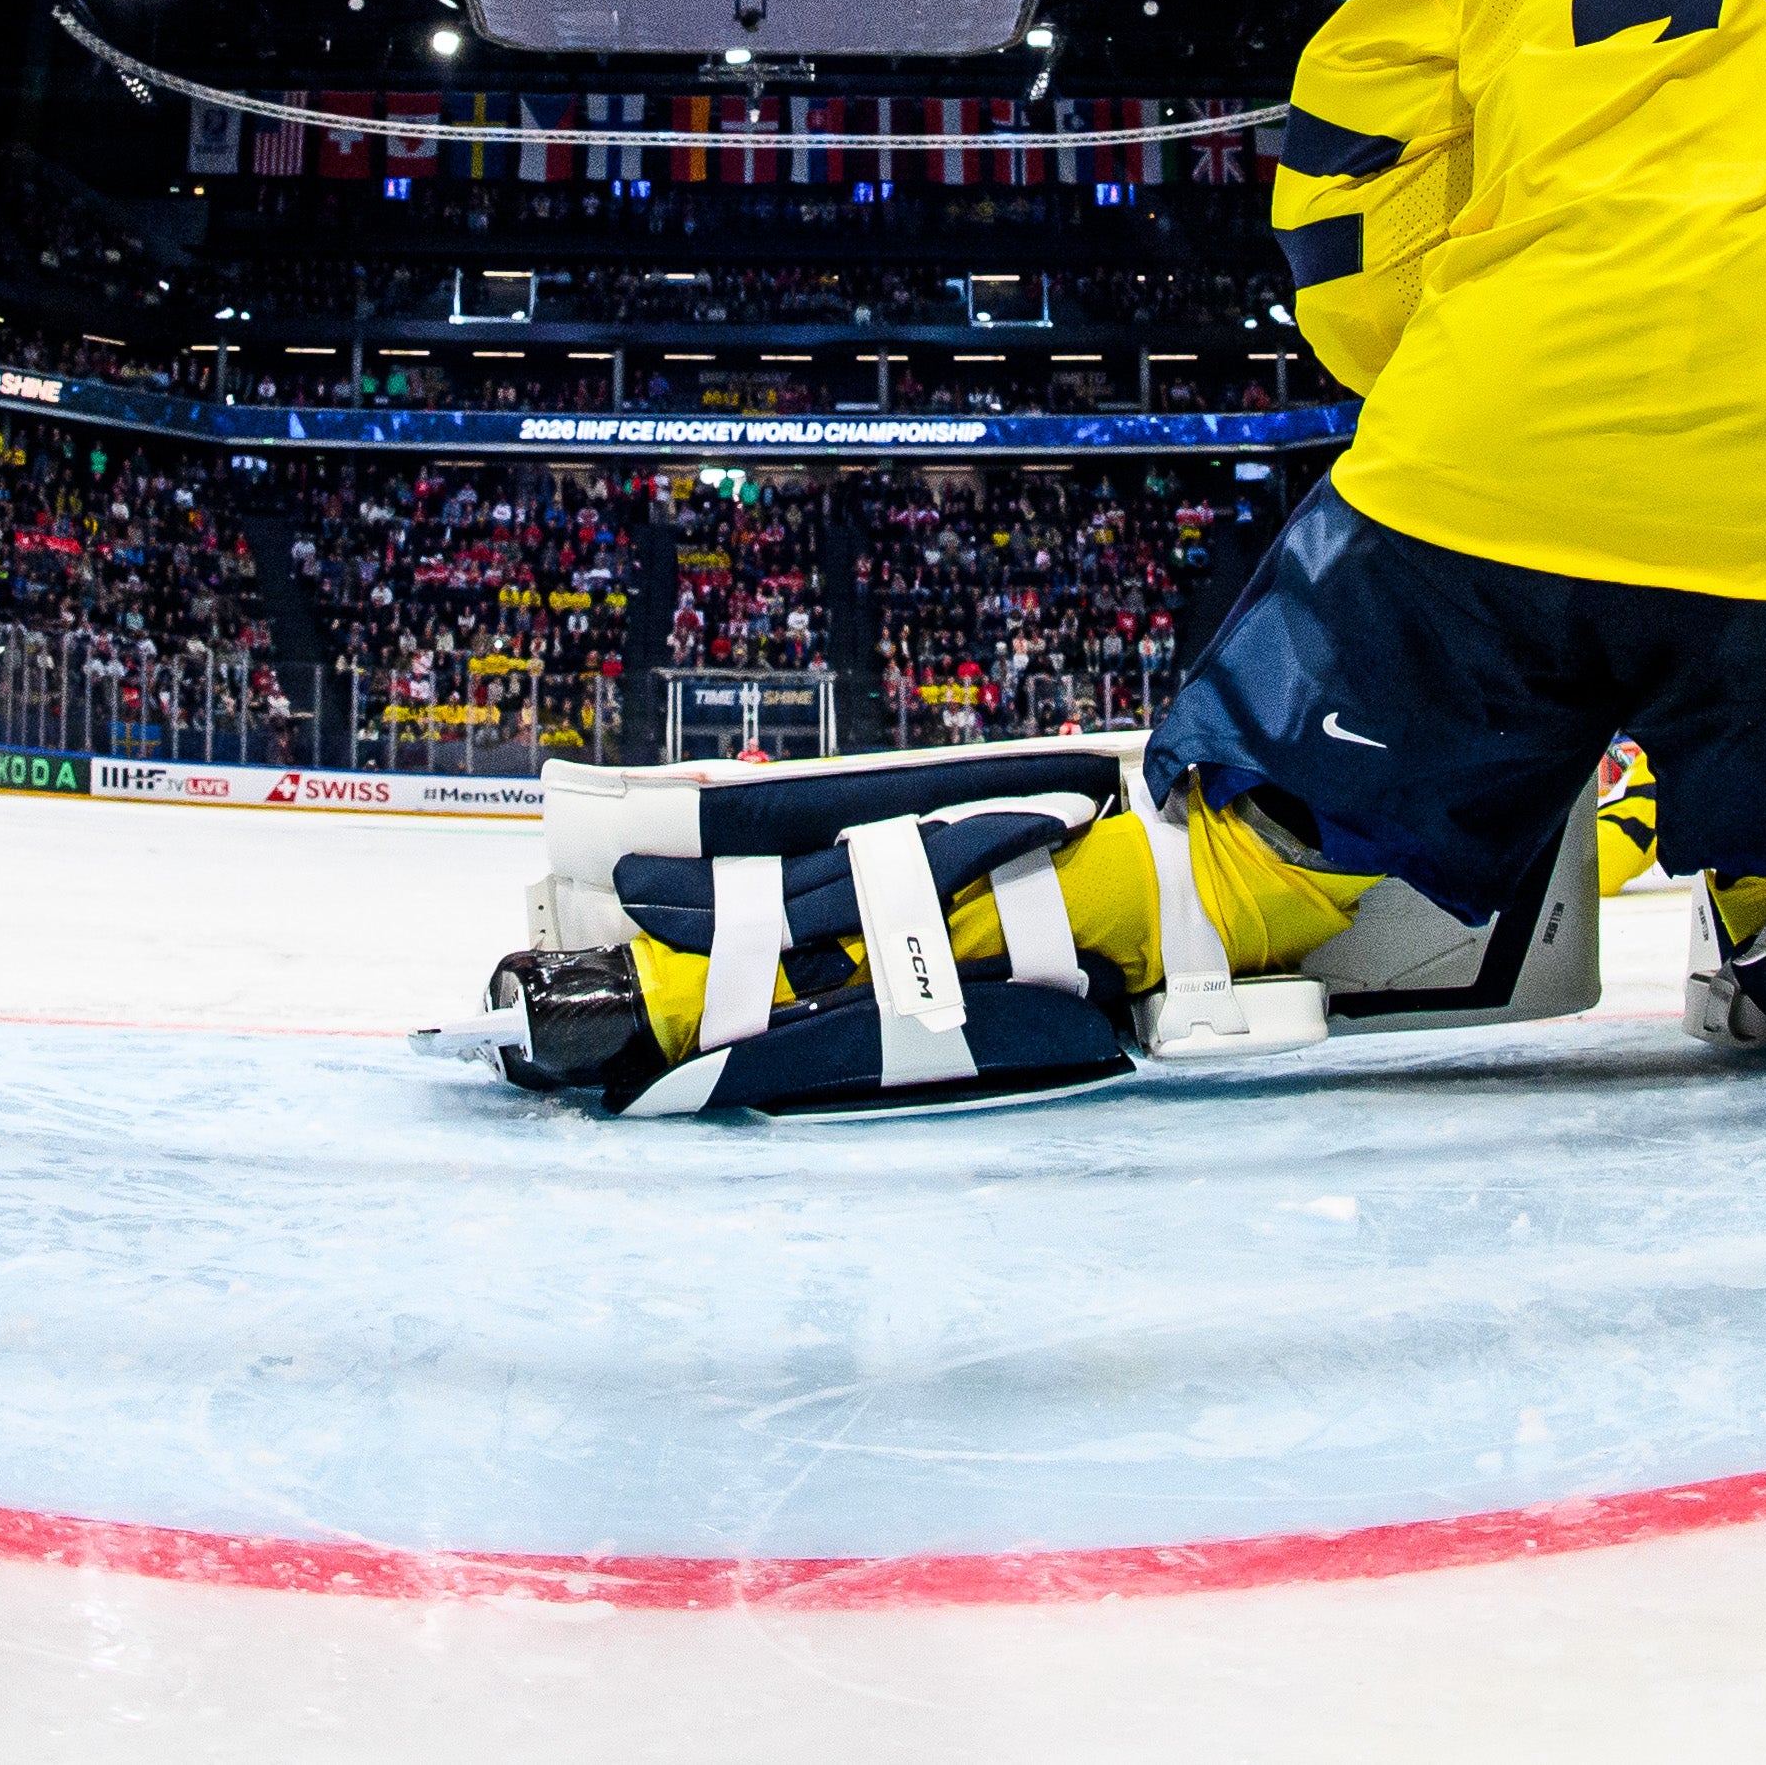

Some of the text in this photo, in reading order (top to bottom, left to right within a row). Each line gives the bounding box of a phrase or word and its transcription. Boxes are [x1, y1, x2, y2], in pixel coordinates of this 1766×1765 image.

[0, 372, 63, 403] SHINE
[519, 418, 987, 443] 2026 IIHF ICE HOCKEY WORLD CHAMPIONSHIP
[100, 765, 167, 791] IIHF
[187, 777, 229, 796] LIVE
[304, 779, 390, 803] SWISS
[424, 787, 544, 805] #MensWor
[906, 936, 934, 1000] CCM
